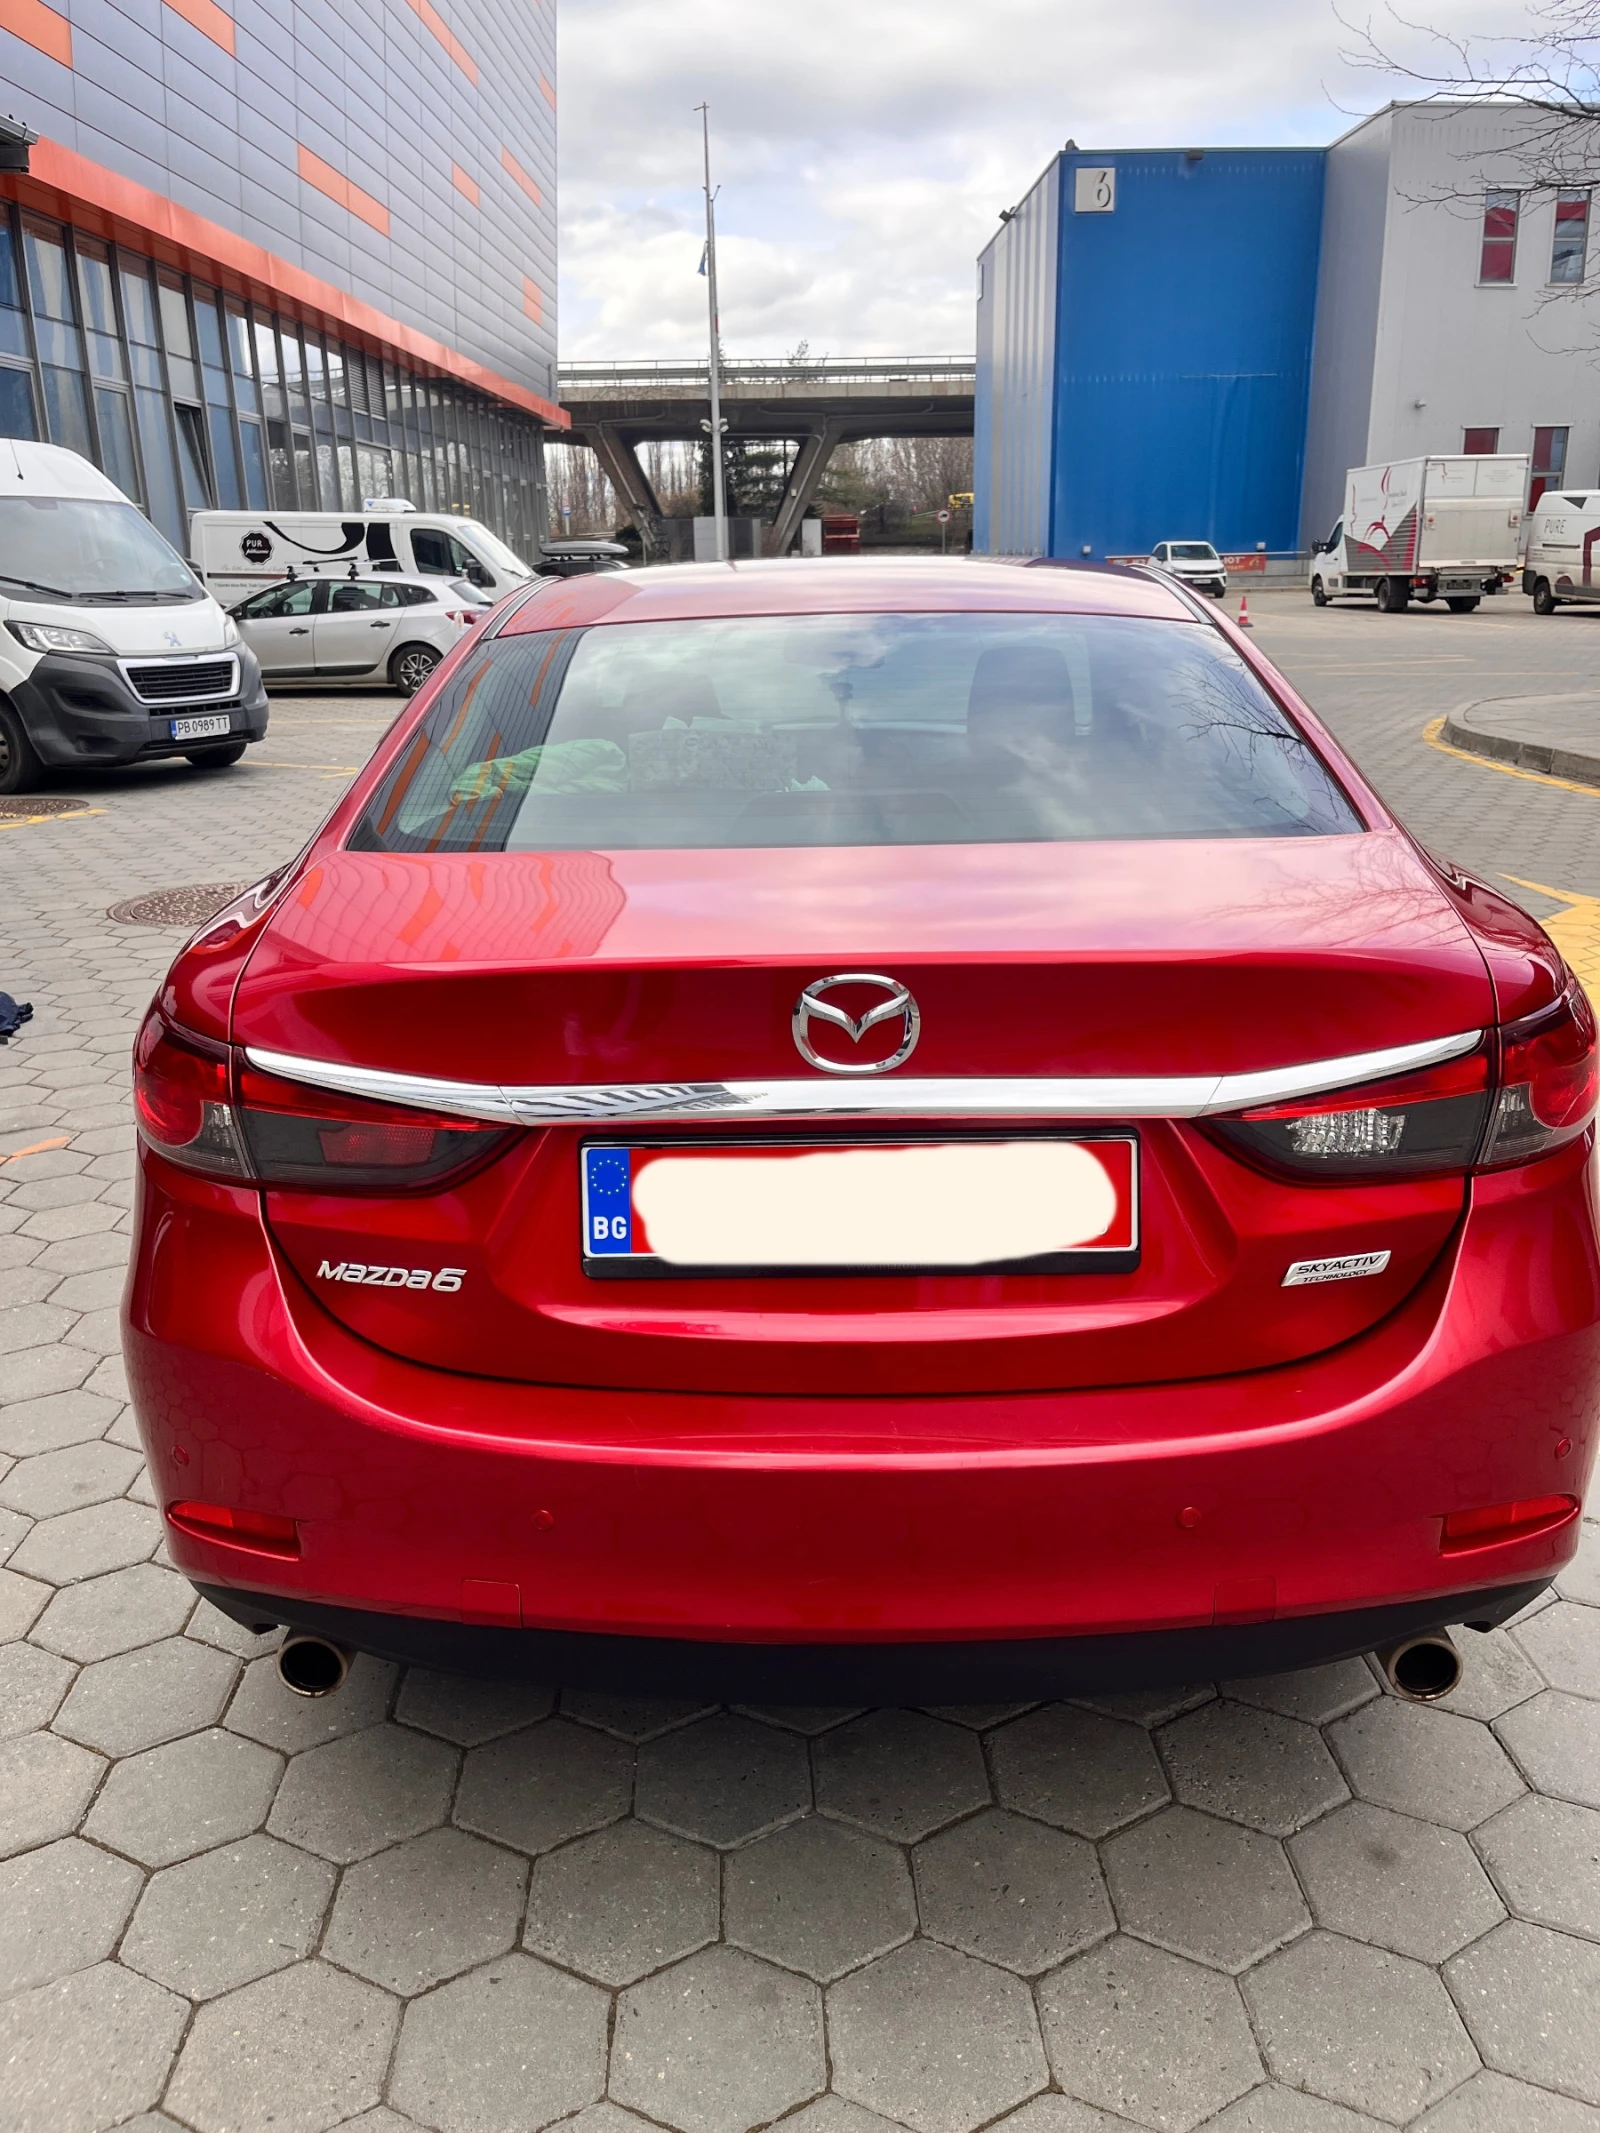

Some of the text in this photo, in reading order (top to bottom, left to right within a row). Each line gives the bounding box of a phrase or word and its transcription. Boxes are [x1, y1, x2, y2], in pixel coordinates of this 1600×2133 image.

[1091, 170, 1112, 208] 6
[1543, 518, 1567, 534] PURE
[246, 539, 263, 547] PUR
[177, 717, 227, 734] PB 0989 TT
[594, 1216, 627, 1240] BG
[1296, 1255, 1381, 1275] SKYACTIV
[1303, 1269, 1370, 1283] TECHNOLOGY
